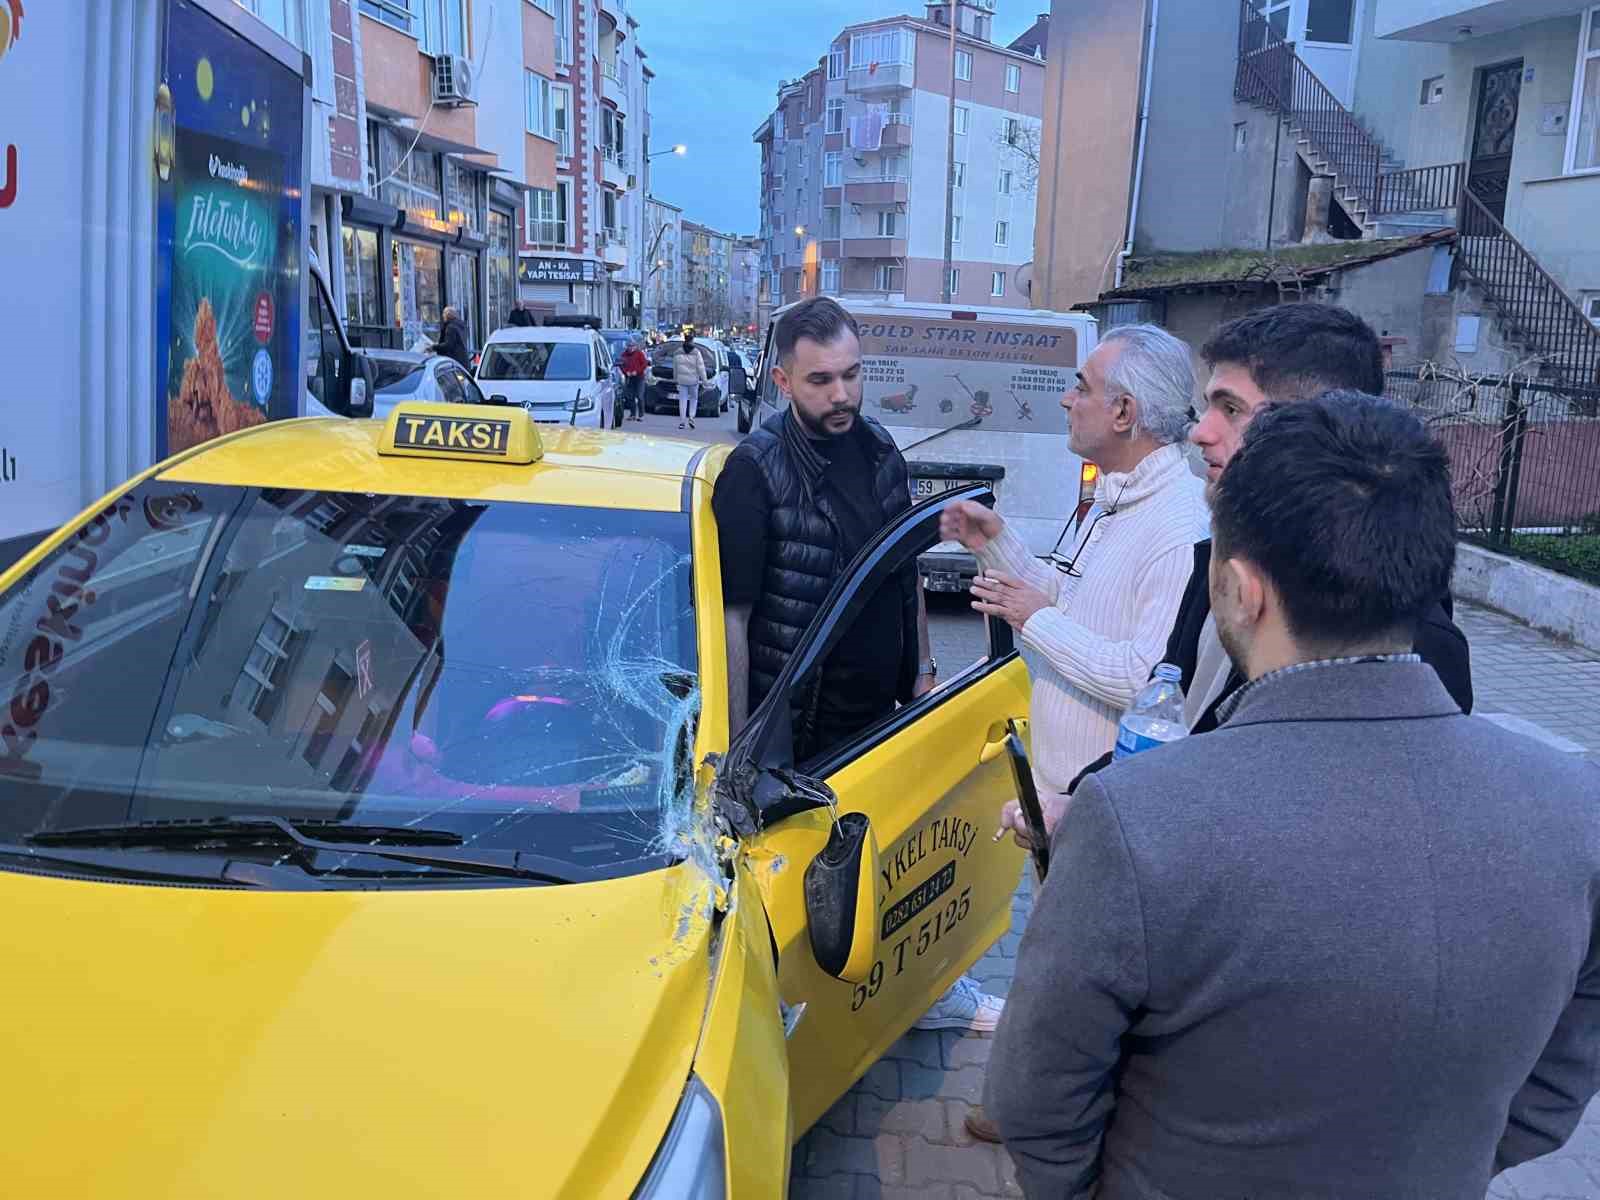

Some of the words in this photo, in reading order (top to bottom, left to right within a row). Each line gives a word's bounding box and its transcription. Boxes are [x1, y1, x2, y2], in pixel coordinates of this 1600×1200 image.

[538, 261, 551, 270] AN
[558, 261, 569, 270] KA
[527, 270, 546, 279] YAPI
[859, 323, 914, 338] GOLD
[921, 327, 977, 344] STAR
[918, 480, 933, 494] 59
[880, 829, 928, 906] YKEL
[893, 936, 912, 977] T
[916, 886, 972, 957] 5125
